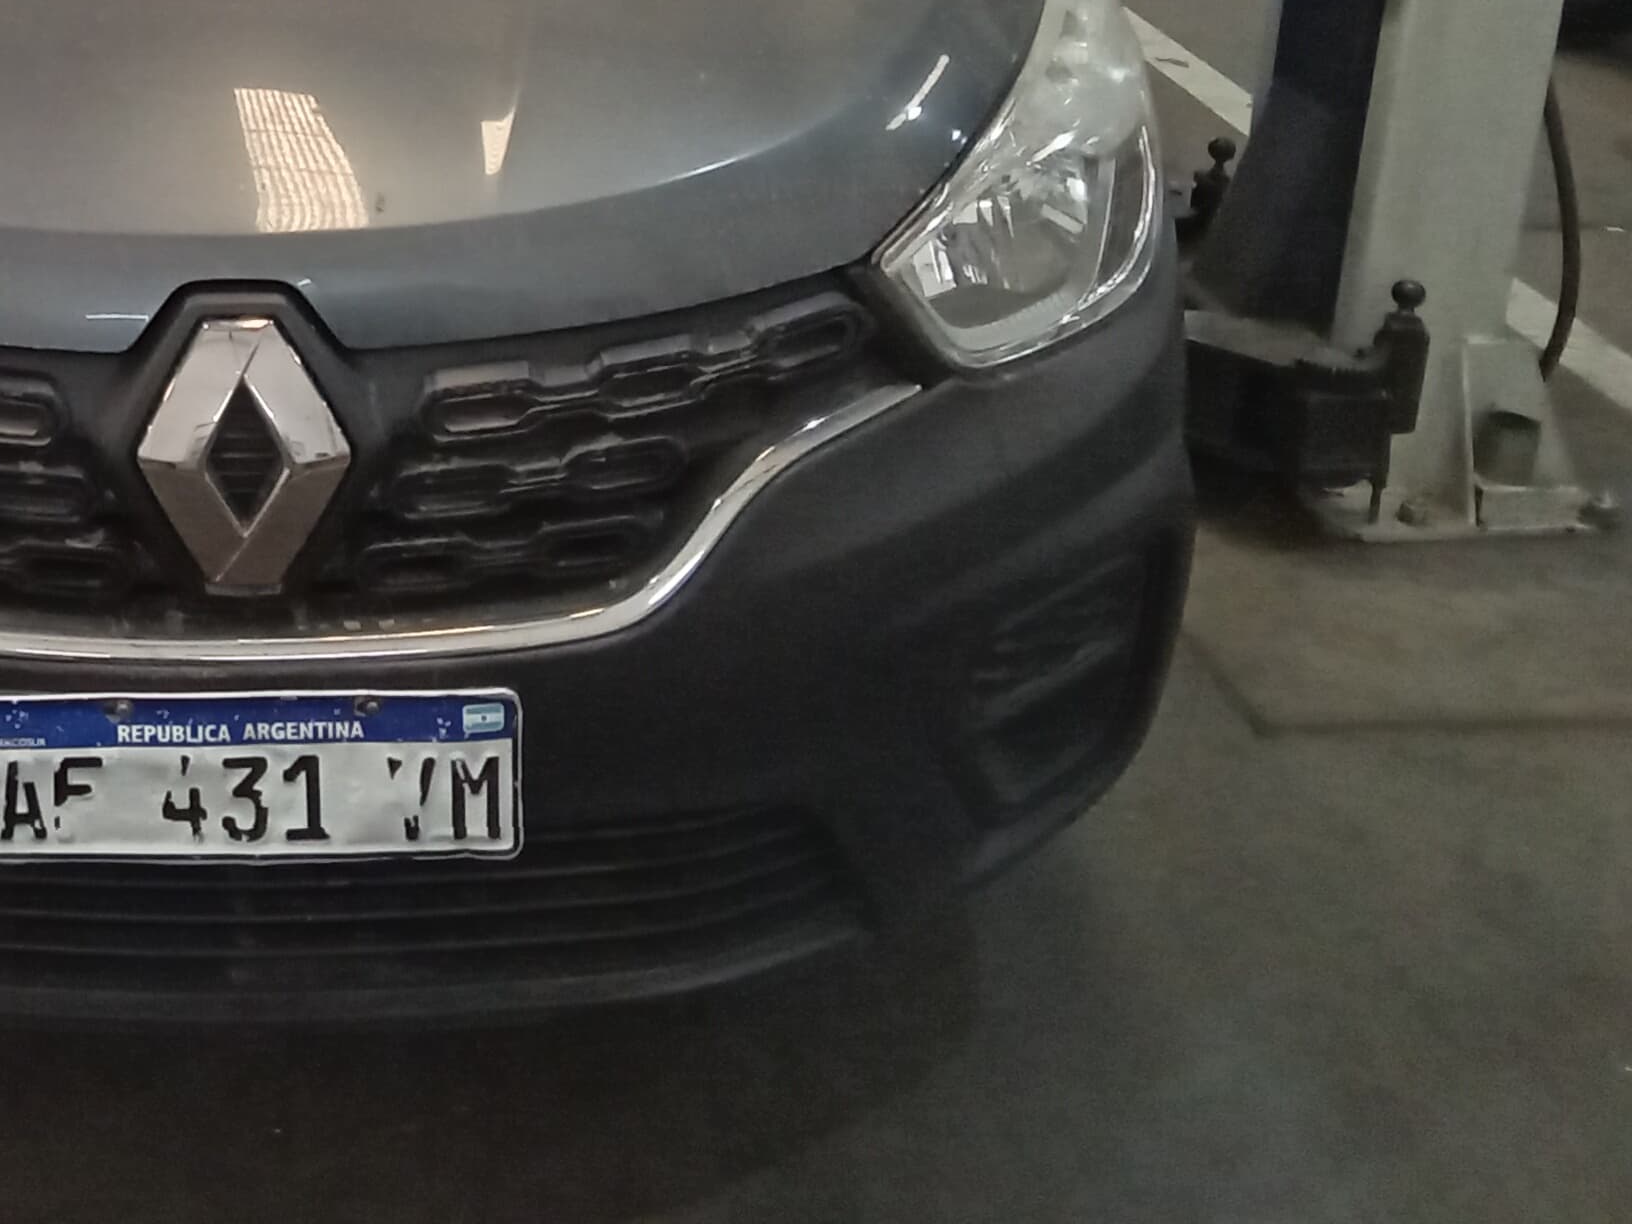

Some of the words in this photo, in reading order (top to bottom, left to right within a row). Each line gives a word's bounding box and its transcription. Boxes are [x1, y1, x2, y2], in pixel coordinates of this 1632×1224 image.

[117, 723, 231, 743] REPUBLICA
[242, 720, 365, 741] ARGENTINA
[161, 754, 331, 843] 431
